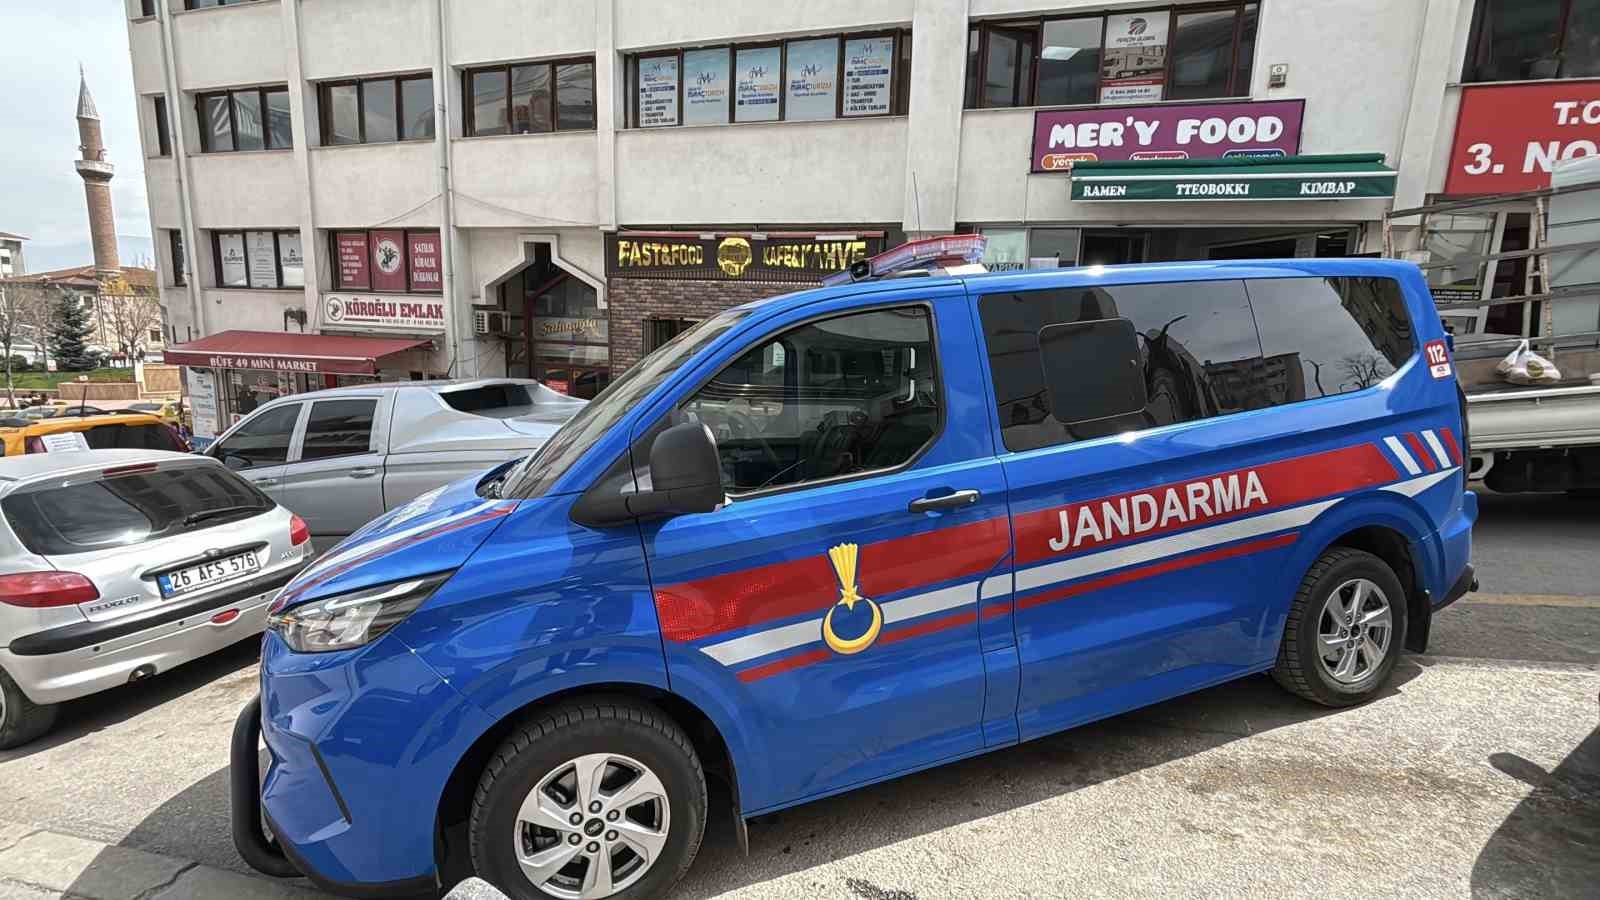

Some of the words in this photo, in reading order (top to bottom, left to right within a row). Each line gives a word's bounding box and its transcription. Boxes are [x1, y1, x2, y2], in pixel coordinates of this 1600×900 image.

[1048, 116, 1160, 149] MER'Y
[1176, 116, 1284, 145] FOOD
[1464, 143, 1505, 175] 3.
[1083, 185, 1127, 197] RAMEN
[1175, 183, 1250, 196] TTEOBOKKI
[1299, 182, 1356, 195] KIMBAP
[618, 240, 704, 268] FAST&FOOD
[344, 298, 397, 317] KÖROĞLU
[400, 303, 443, 319] EMLAK
[210, 357, 233, 368] BÜFE
[236, 359, 248, 368] 49
[277, 360, 317, 371] MARKET
[1427, 344, 1446, 364] 112
[1049, 471, 1269, 552] JANDARMA
[171, 569, 191, 589] 26
[198, 562, 225, 582] AFS
[230, 552, 256, 572] 576
